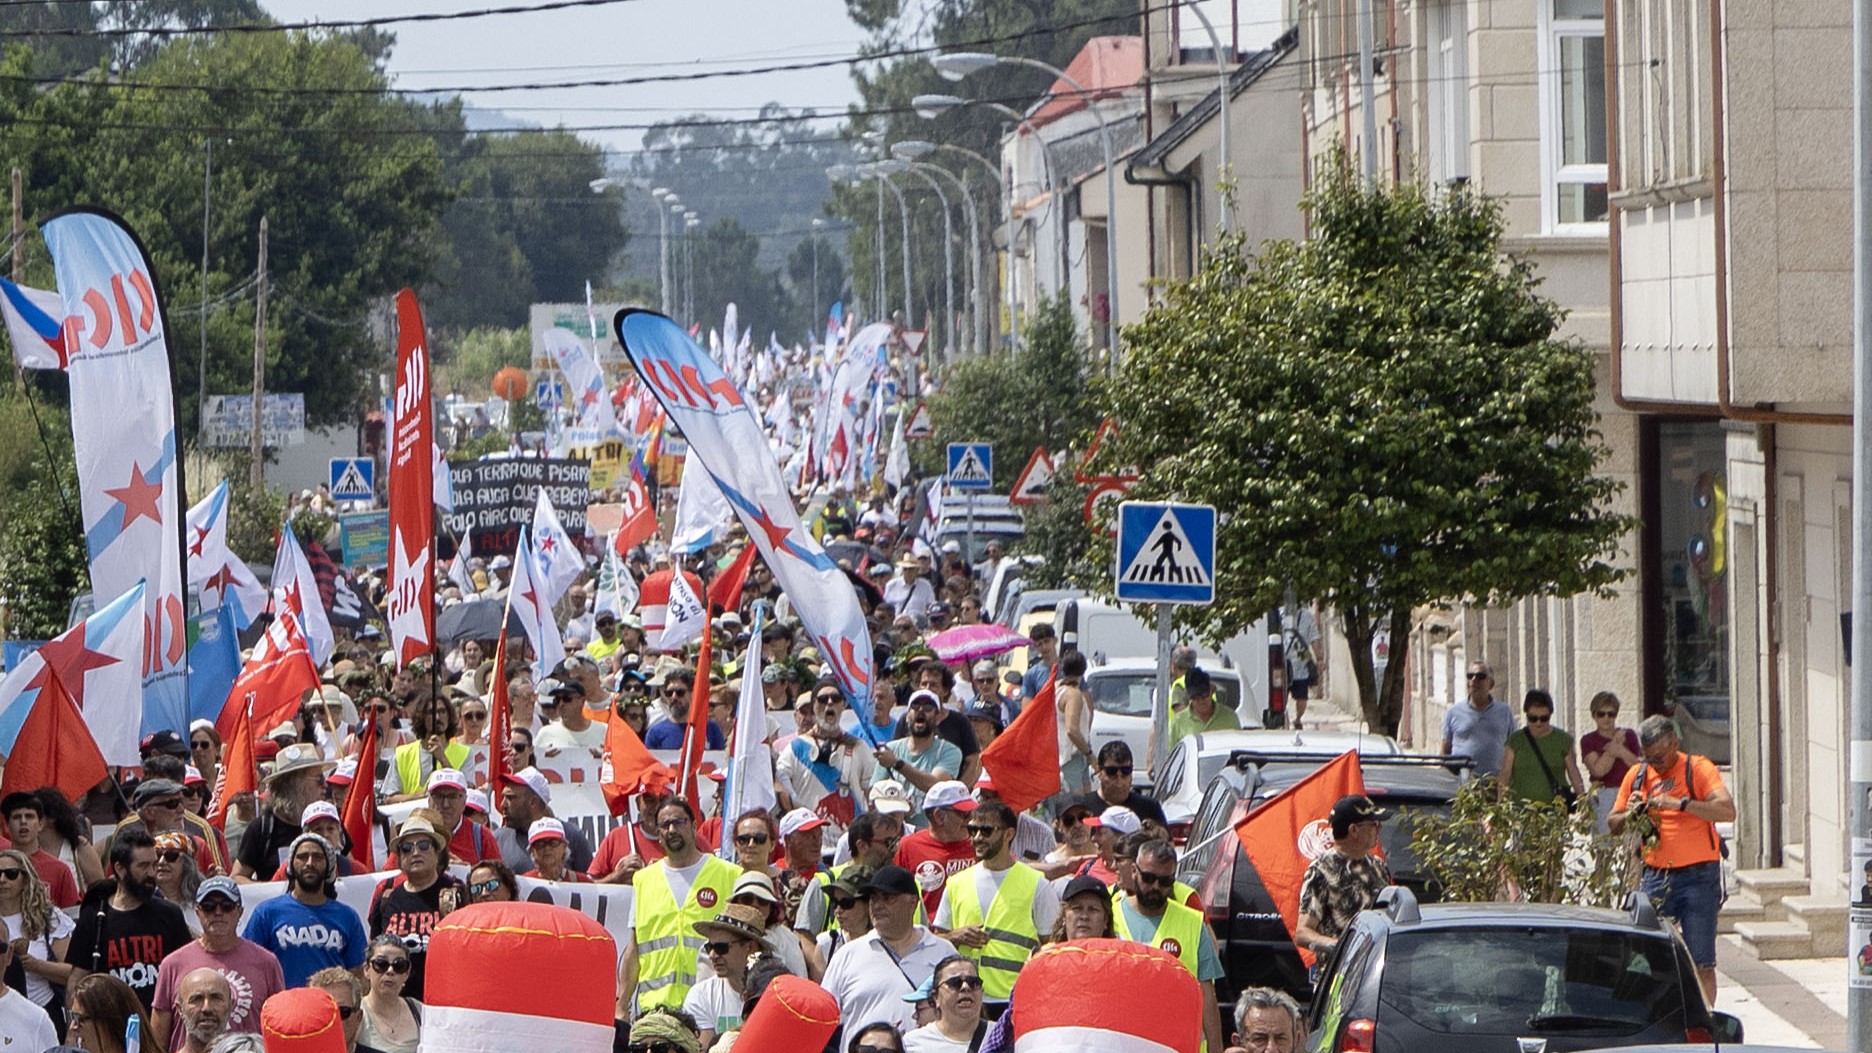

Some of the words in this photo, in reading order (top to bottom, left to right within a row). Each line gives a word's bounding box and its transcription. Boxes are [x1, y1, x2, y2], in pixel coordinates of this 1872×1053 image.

[450, 469, 473, 483] OLA
[476, 462, 518, 483] TERRA
[520, 463, 544, 480] QUE
[452, 490, 473, 506] OLA
[510, 506, 533, 525] QUE
[276, 923, 343, 951] NADA
[107, 933, 163, 968] ALTRI
